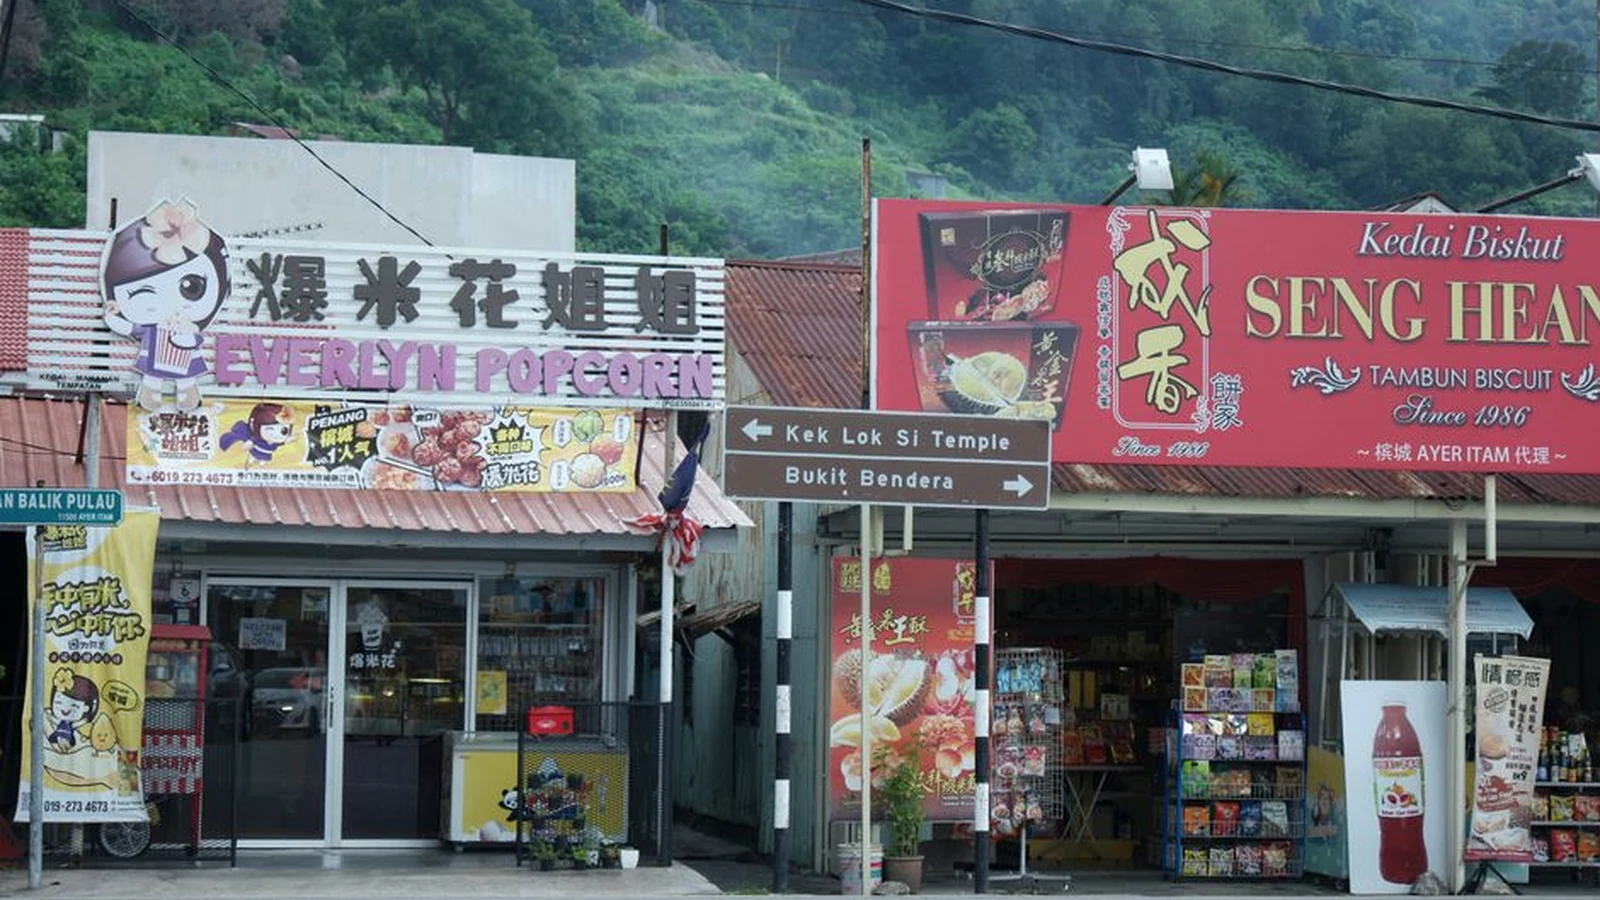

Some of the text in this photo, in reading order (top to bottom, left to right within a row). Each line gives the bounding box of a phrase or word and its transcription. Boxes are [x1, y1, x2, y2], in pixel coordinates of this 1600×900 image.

[1357, 222, 1564, 261] Kedai Biskut
[246, 251, 700, 335] 爆米花姐姐
[1245, 273, 1428, 342] SENG
[214, 334, 715, 400] EVERLYN POPCORN
[1369, 364, 1553, 391] TAMBUN BISCUIT
[310, 407, 366, 431] PENANG
[1391, 392, 1532, 427] Since 1986
[785, 424, 1010, 452] Kek Lok Si Temple
[1111, 435, 1162, 458] Since
[1374, 442, 1551, 466] 槟城 AYER ITAM 代理
[146, 472, 180, 482] +6019
[182, 472, 202, 482] 273
[205, 473, 234, 484] 4673
[785, 466, 954, 490] Bukit Bendera
[0, 492, 115, 510] N BALIK PULAU
[79, 513, 95, 521] AYER
[44, 800, 82, 813] 019-273
[85, 801, 109, 813] 4673
